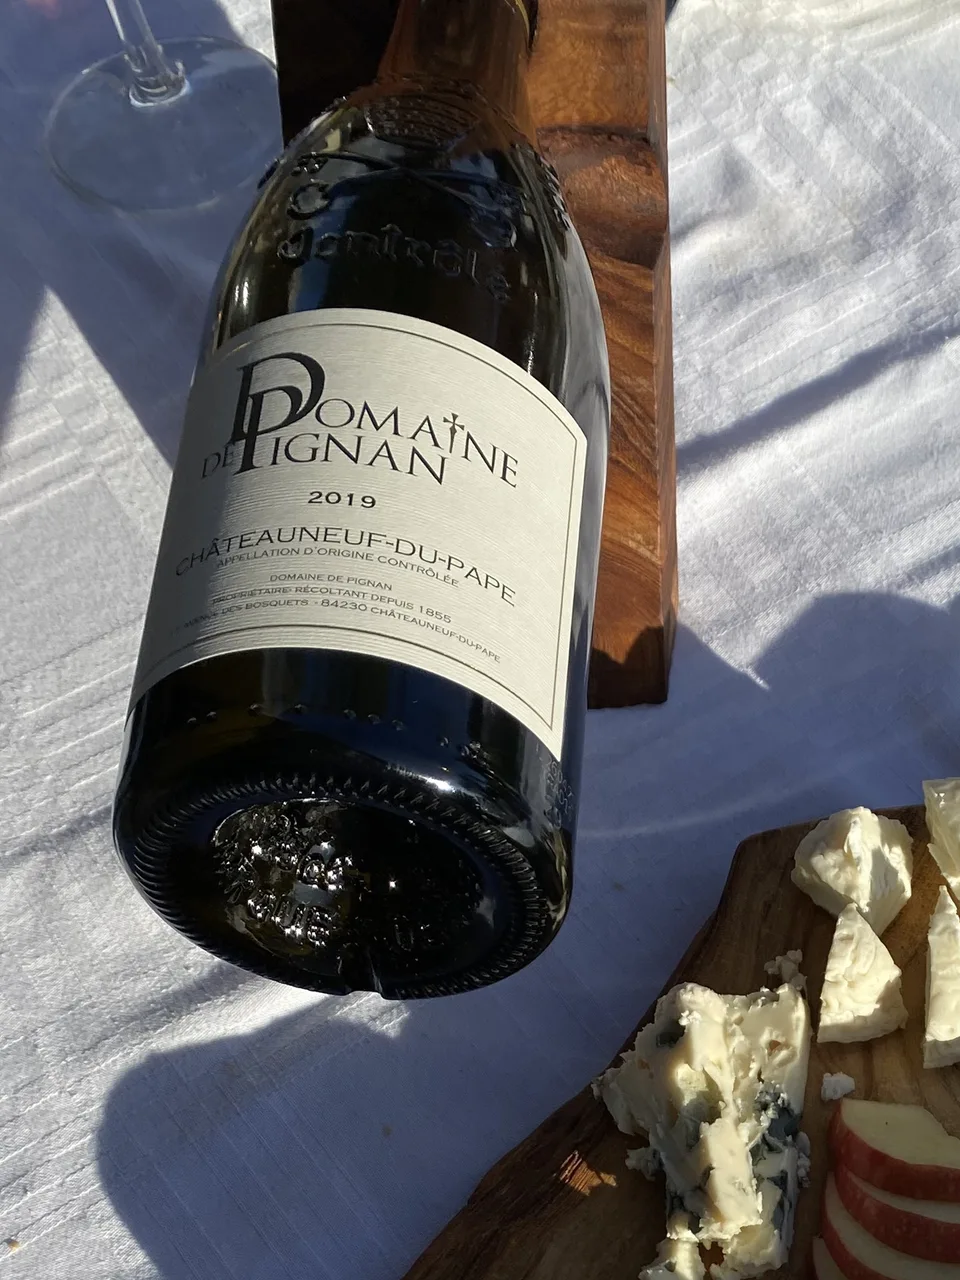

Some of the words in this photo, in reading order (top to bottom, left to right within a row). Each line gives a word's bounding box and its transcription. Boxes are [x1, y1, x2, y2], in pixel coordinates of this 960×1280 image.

[202, 442, 236, 480] DE
[233, 385, 449, 486] PIGNAN
[229, 351, 519, 488] DOMAINE
[307, 490, 377, 509] 2019
[176, 527, 516, 607] CHÂTEAUNEUF-DU-PAPE
[217, 547, 300, 568] APPELLATION
[303, 546, 374, 562] D'ORIGINE
[377, 555, 460, 588] CONTRÔLÉE
[269, 573, 326, 582] DOMAINE
[328, 574, 343, 583] DE
[346, 576, 393, 591] PIGNAN
[245, 598, 309, 610] BOSQUETS
[320, 599, 367, 612] 84230
[370, 606, 501, 663] CHÂTEAUNEUF-DU-PAPE
[294, 585, 368, 600] RÉCOLTANT
[370, 593, 414, 610] DEPUIS
[418, 605, 452, 624] 1855
